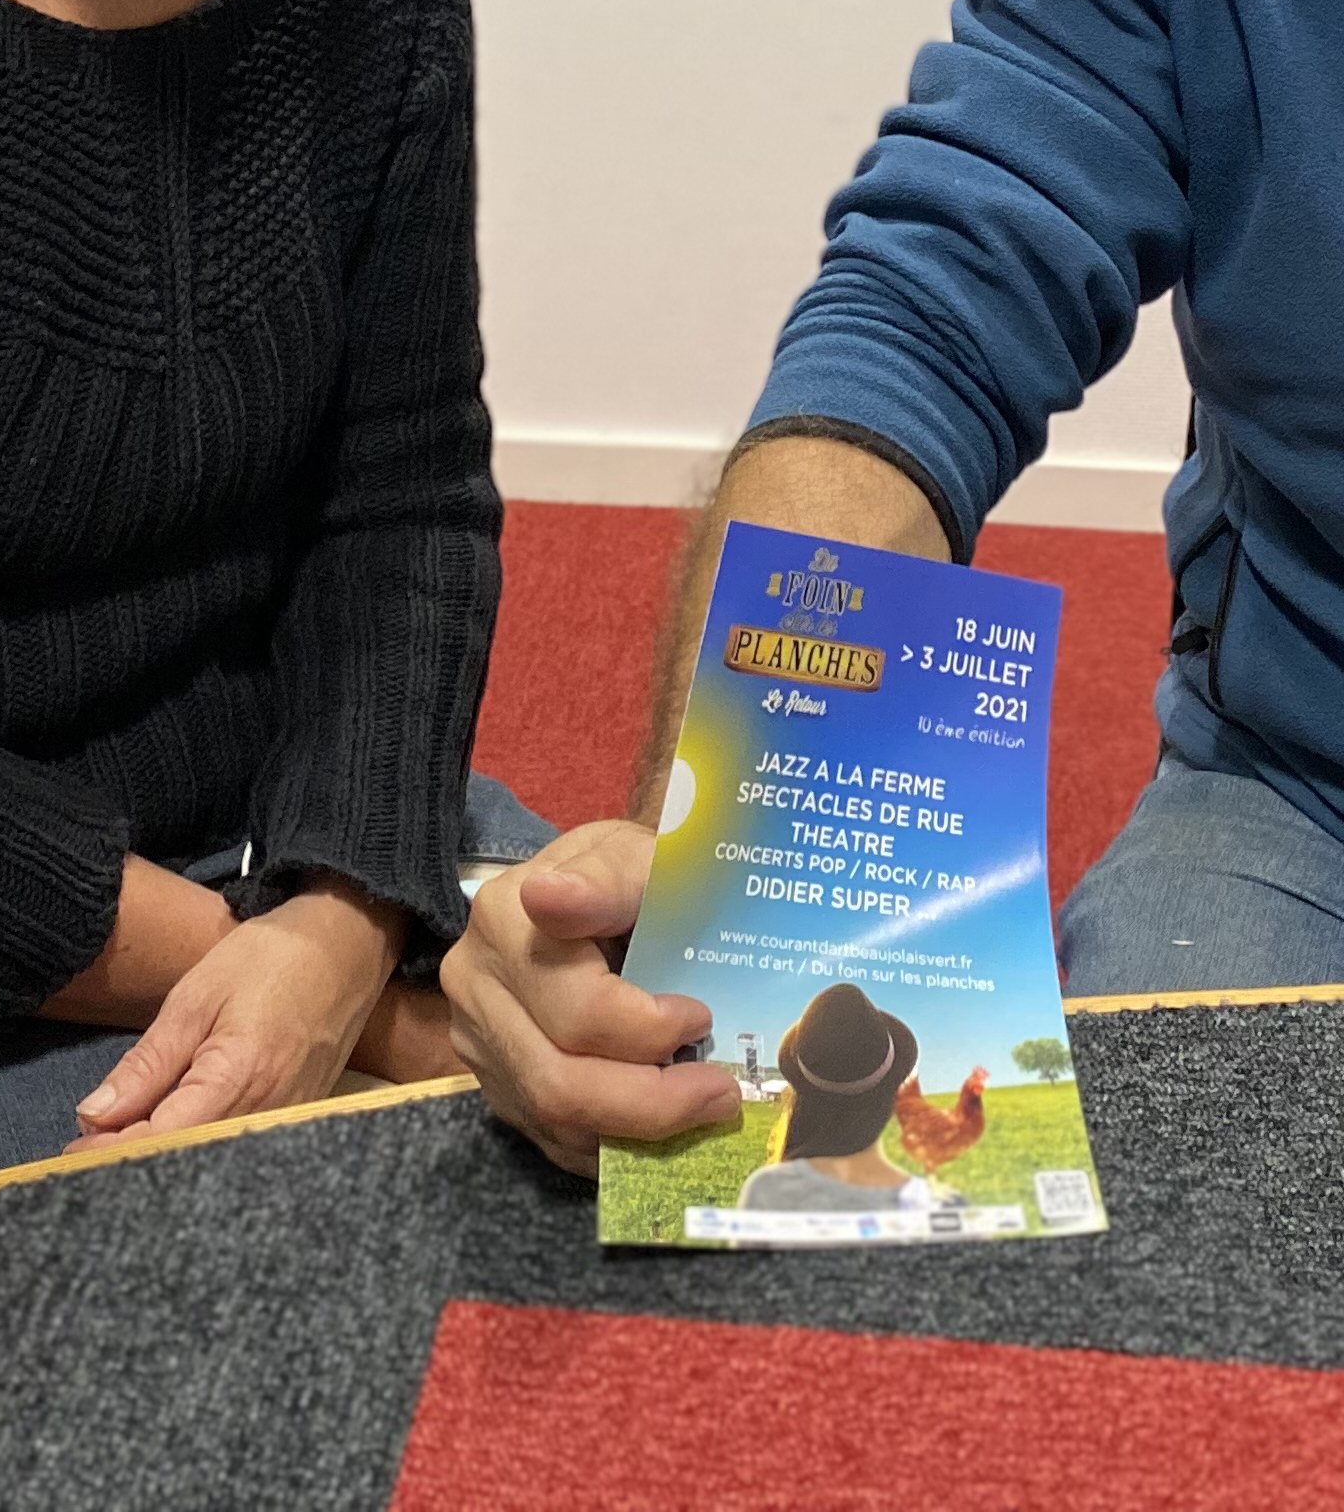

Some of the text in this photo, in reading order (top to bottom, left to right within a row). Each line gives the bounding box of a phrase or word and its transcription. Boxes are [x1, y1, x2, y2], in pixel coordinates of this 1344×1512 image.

[782, 570, 851, 617] FOIN
[731, 629, 880, 686] PLANCHES
[956, 617, 1036, 655] 18 JUIN
[920, 645, 935, 669] 3
[939, 650, 1033, 688] JUILLET
[762, 688, 828, 717] Le Retour
[974, 692, 1028, 723] 2021
[968, 724, 1025, 749] édition
[755, 751, 947, 800] JAZZ A LA FERME
[736, 781, 964, 835] SPECTACLES DE RUE
[791, 821, 895, 858] THEATRE
[715, 842, 976, 894] CONCERTS POP / ROCK / RAP
[745, 875, 824, 906] DIDIER
[831, 886, 910, 918] SUPER
[697, 949, 754, 968] courant
[759, 953, 794, 973] d'art
[812, 960, 833, 977] Du
[838, 963, 868, 981] foin
[871, 970, 895, 985] sur
[900, 969, 922, 987] les
[926, 973, 996, 992] planches
[719, 929, 973, 970] www.courantdartbeaujolaisvert.fr
